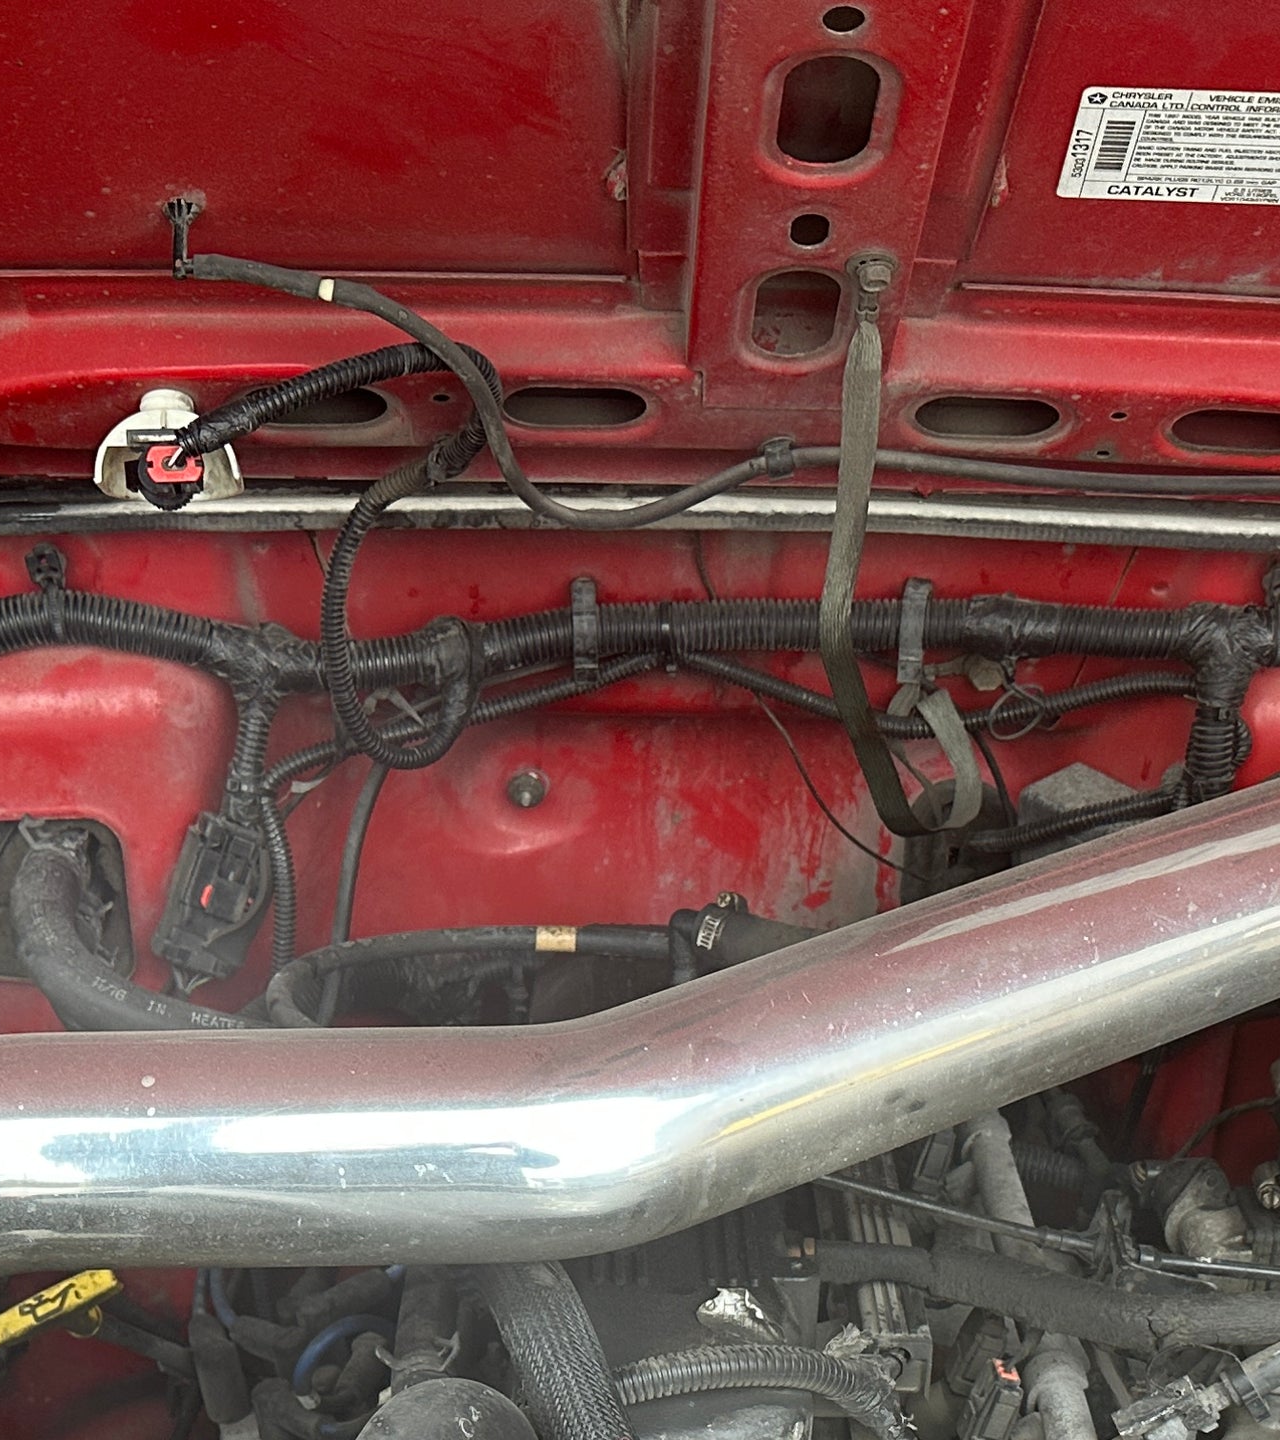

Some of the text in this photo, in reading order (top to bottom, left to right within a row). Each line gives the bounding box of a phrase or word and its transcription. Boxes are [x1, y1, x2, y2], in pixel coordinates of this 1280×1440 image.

[1112, 91, 1173, 100] CHRYSLER
[1209, 94, 1255, 104] VEHICLE
[1109, 101, 1158, 109] CANADA
[1190, 102, 1241, 112] CONTROL
[1107, 184, 1199, 198] CATALYST
